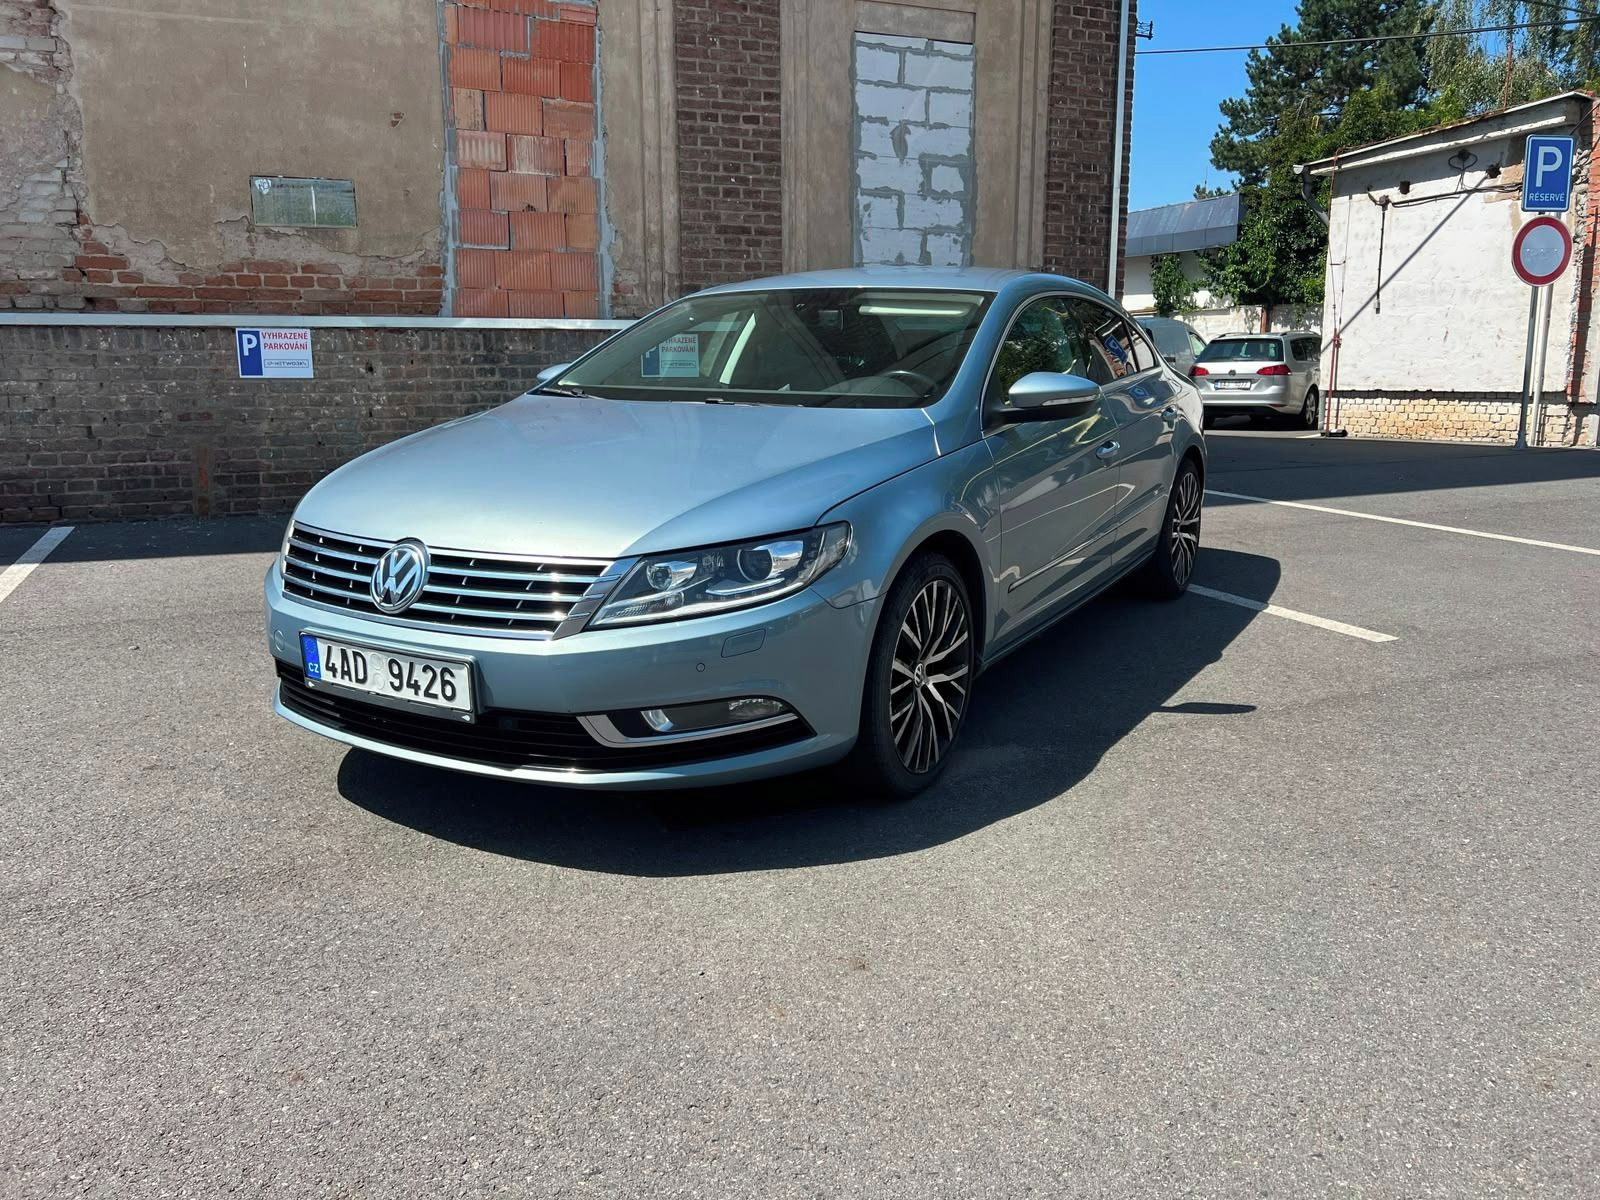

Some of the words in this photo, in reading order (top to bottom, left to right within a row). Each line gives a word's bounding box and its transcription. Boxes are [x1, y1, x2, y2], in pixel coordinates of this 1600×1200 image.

[1536, 145, 1563, 187] P
[242, 334, 257, 356] P
[261, 331, 308, 339] VYHRAZENÉ
[263, 342, 307, 350] PARKOVÁNÍ
[373, 547, 423, 608] VW
[308, 662, 320, 673] CZ
[325, 645, 369, 685] 4AD
[387, 658, 457, 702] 9426
